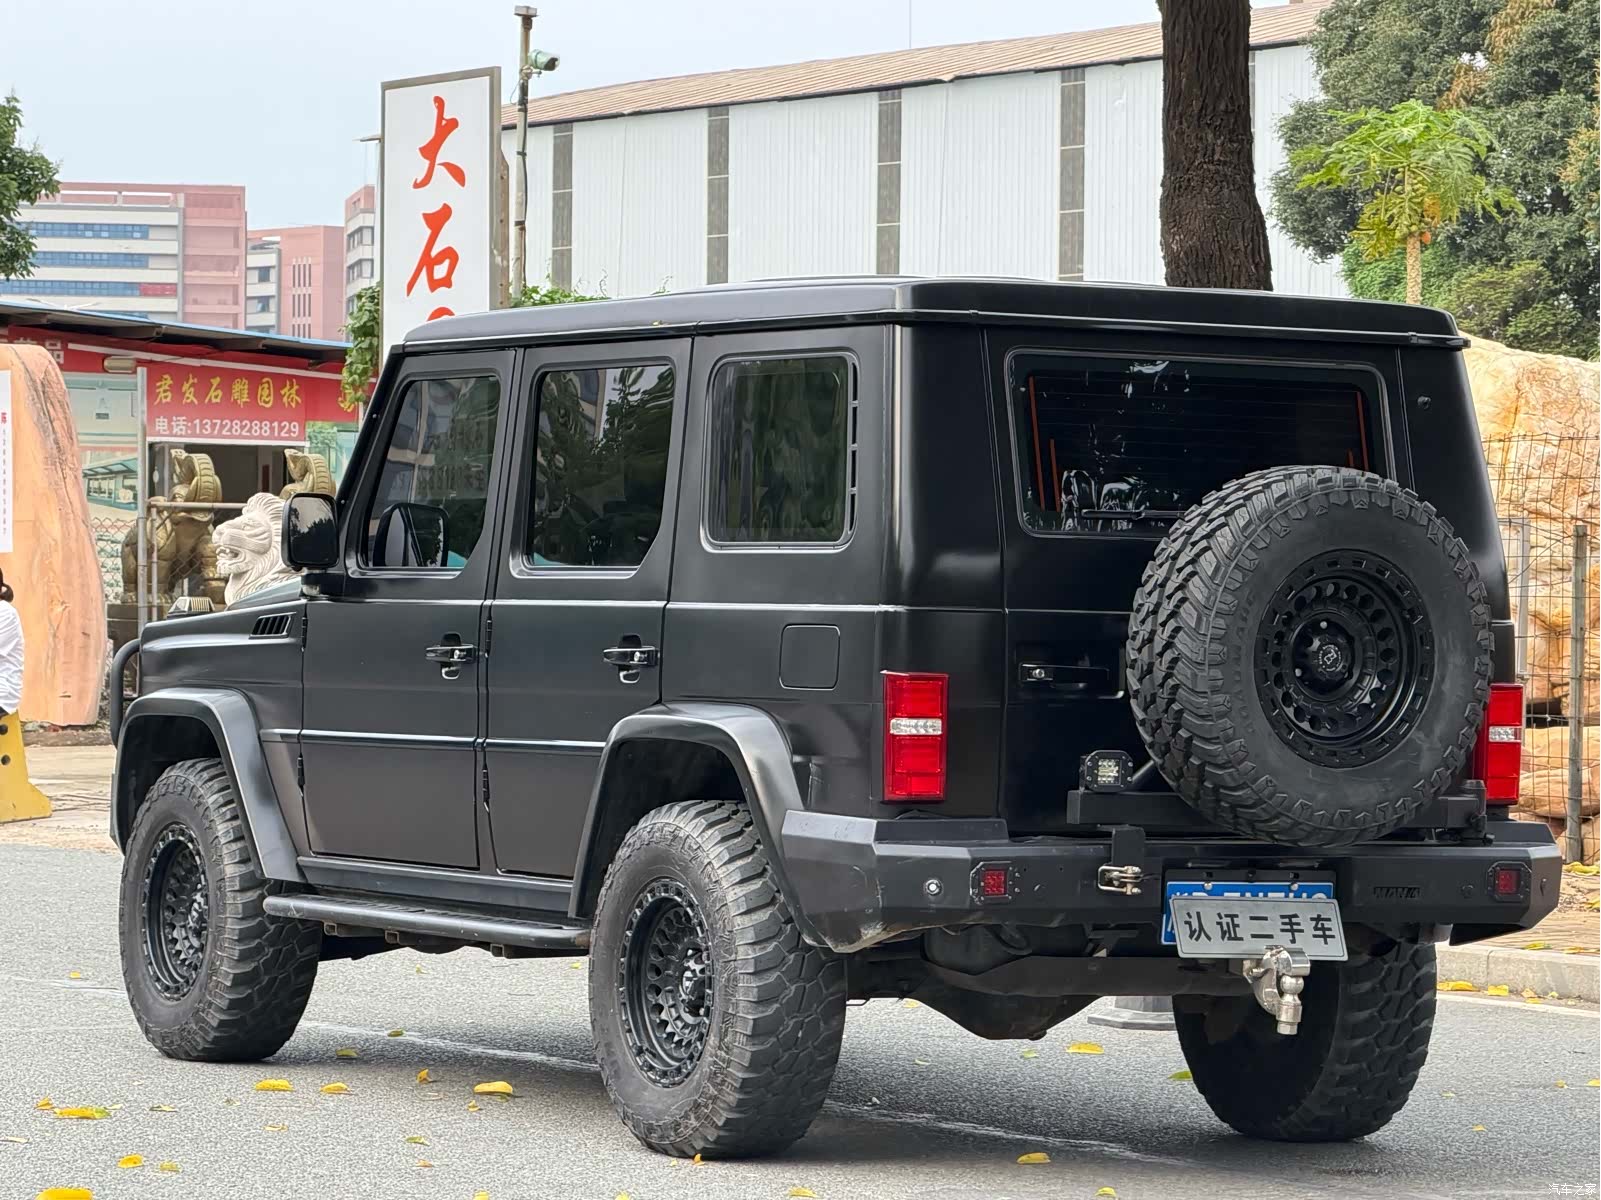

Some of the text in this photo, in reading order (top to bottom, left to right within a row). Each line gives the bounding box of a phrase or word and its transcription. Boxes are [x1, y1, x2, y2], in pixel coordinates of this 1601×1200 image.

[406, 95, 466, 322] 大石
[154, 374, 302, 409] 君发石雕园林
[155, 416, 300, 437] 电话:13728288129
[1184, 911, 1336, 945] 认证二手车
